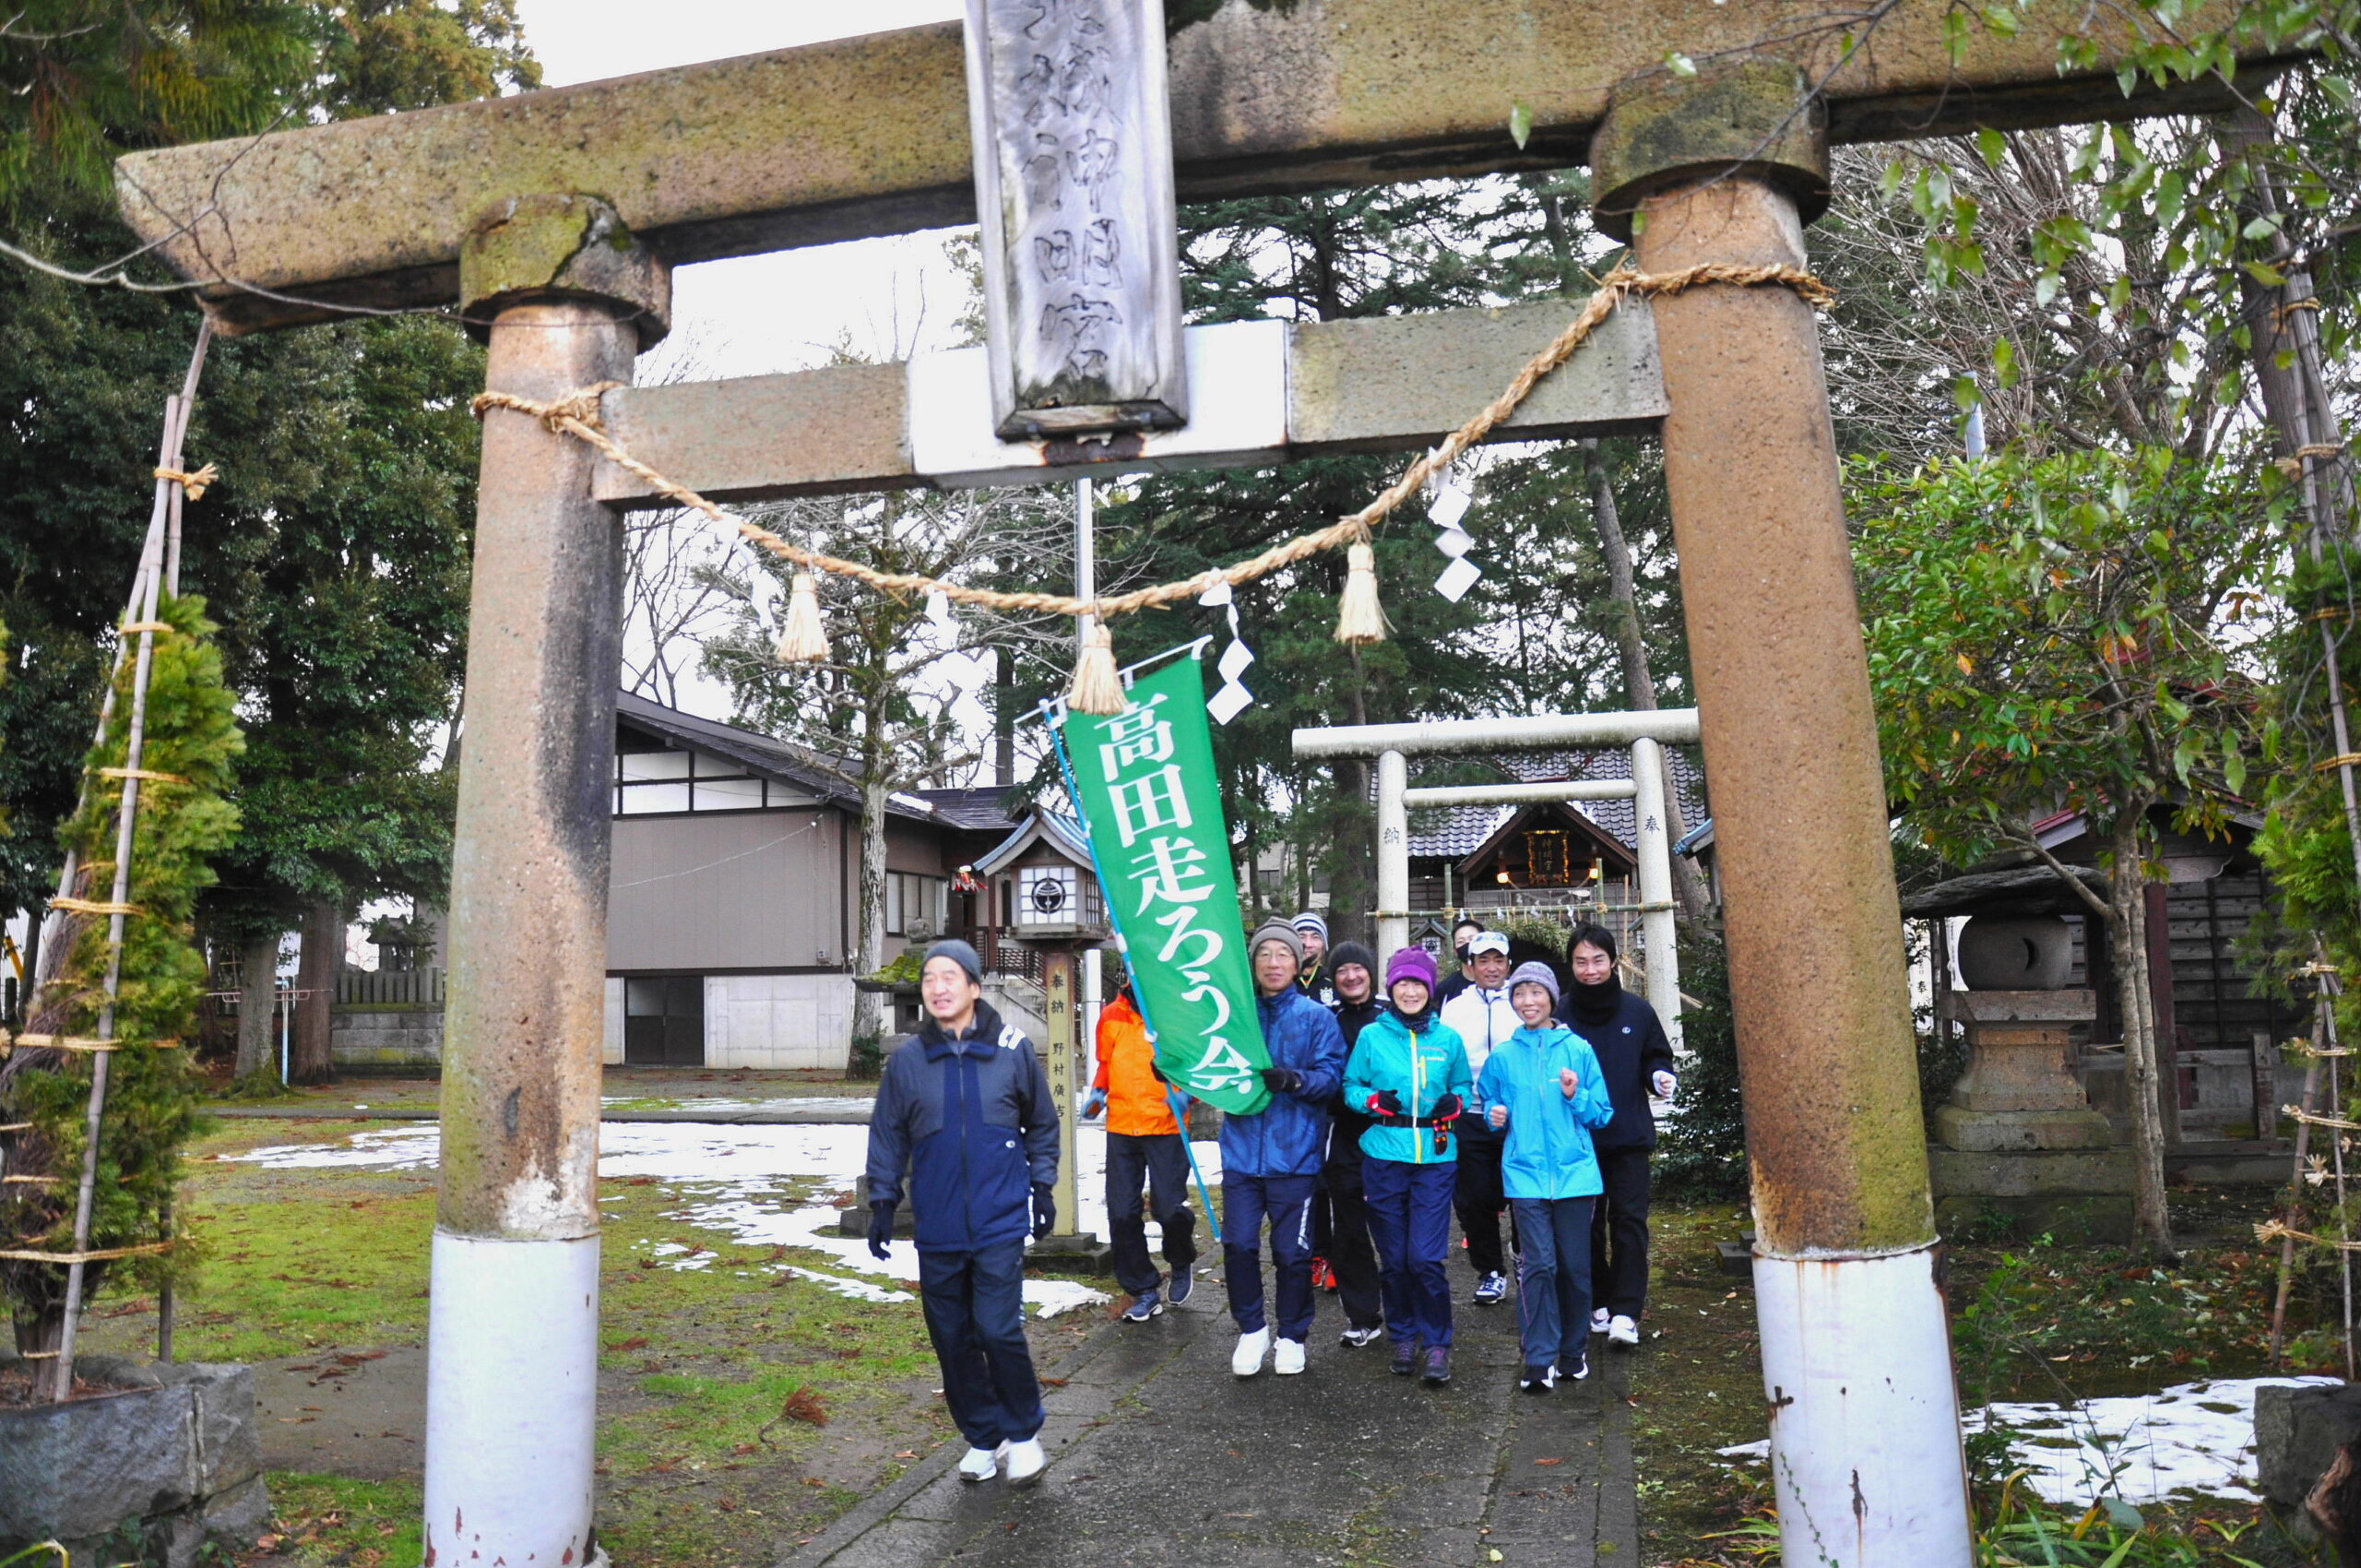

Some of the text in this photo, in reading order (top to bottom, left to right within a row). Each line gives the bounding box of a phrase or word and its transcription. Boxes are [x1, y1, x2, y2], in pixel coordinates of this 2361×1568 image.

[1051, 974, 1064, 1014] 奉納
[1095, 694, 1255, 1094] 高田走ろう会
